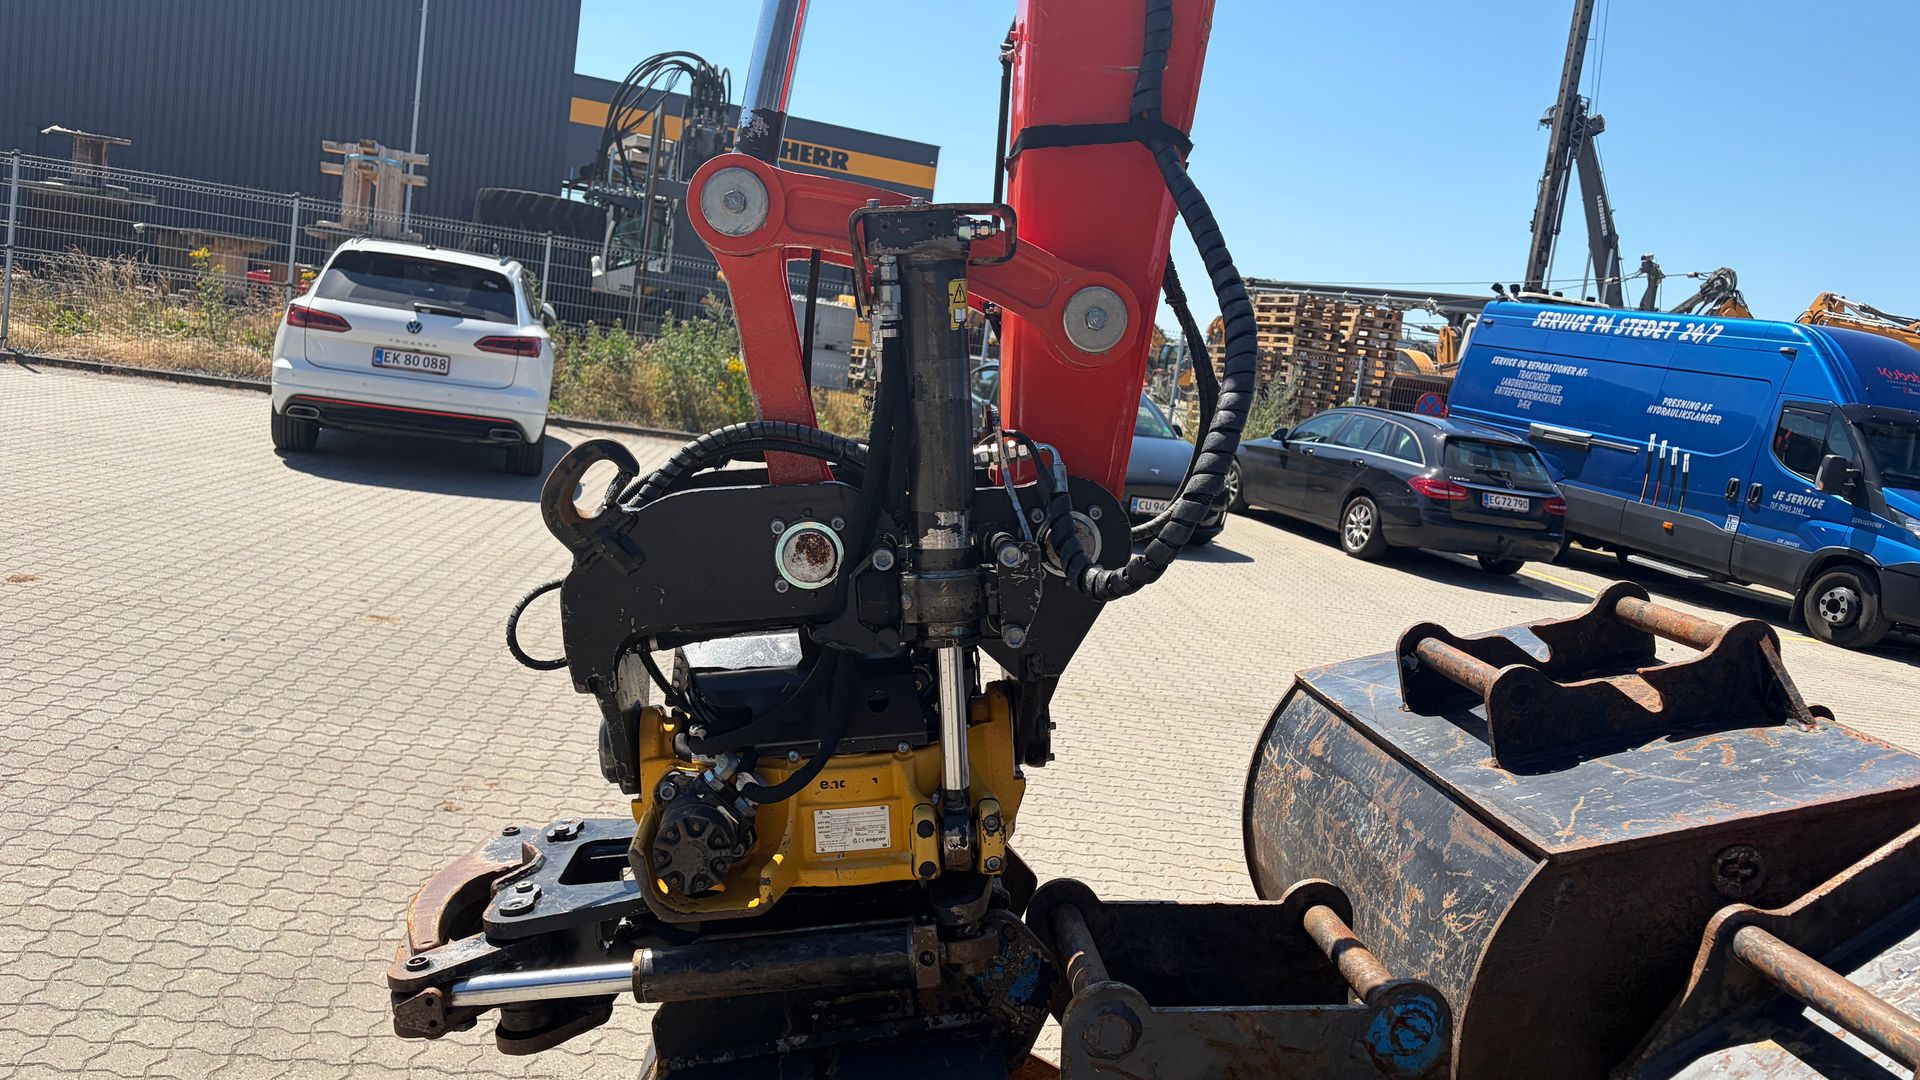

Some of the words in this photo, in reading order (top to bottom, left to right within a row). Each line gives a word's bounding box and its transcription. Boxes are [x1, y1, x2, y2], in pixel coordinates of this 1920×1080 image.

[780, 140, 849, 170] HERR
[1532, 310, 1593, 332] SERVICE
[1592, 313, 1616, 334] PÅ
[1613, 317, 1680, 340] STEDET
[1678, 322, 1724, 345] 24/7
[384, 351, 401, 364] EK
[404, 354, 420, 367] 80
[422, 357, 447, 370] 088
[1491, 355, 1517, 367] SERVICE
[1517, 359, 1528, 369] OG
[1526, 361, 1577, 376] REPARATIONER
[1575, 368, 1589, 377] AF:
[1517, 370, 1551, 383] TRAKTORER
[1876, 366, 1920, 384] Kubot
[1661, 397, 1701, 411] PRESNING
[1700, 403, 1713, 413] AF
[1646, 405, 1722, 425] HYDRAULIKSLANGER
[1138, 500, 1151, 510] CU
[1153, 502, 1165, 511] 94
[1489, 495, 1501, 505] EG
[1501, 497, 1512, 507] 72
[1513, 499, 1528, 509] 790
[1772, 490, 1786, 501] JE
[1785, 492, 1826, 510] SERVICE
